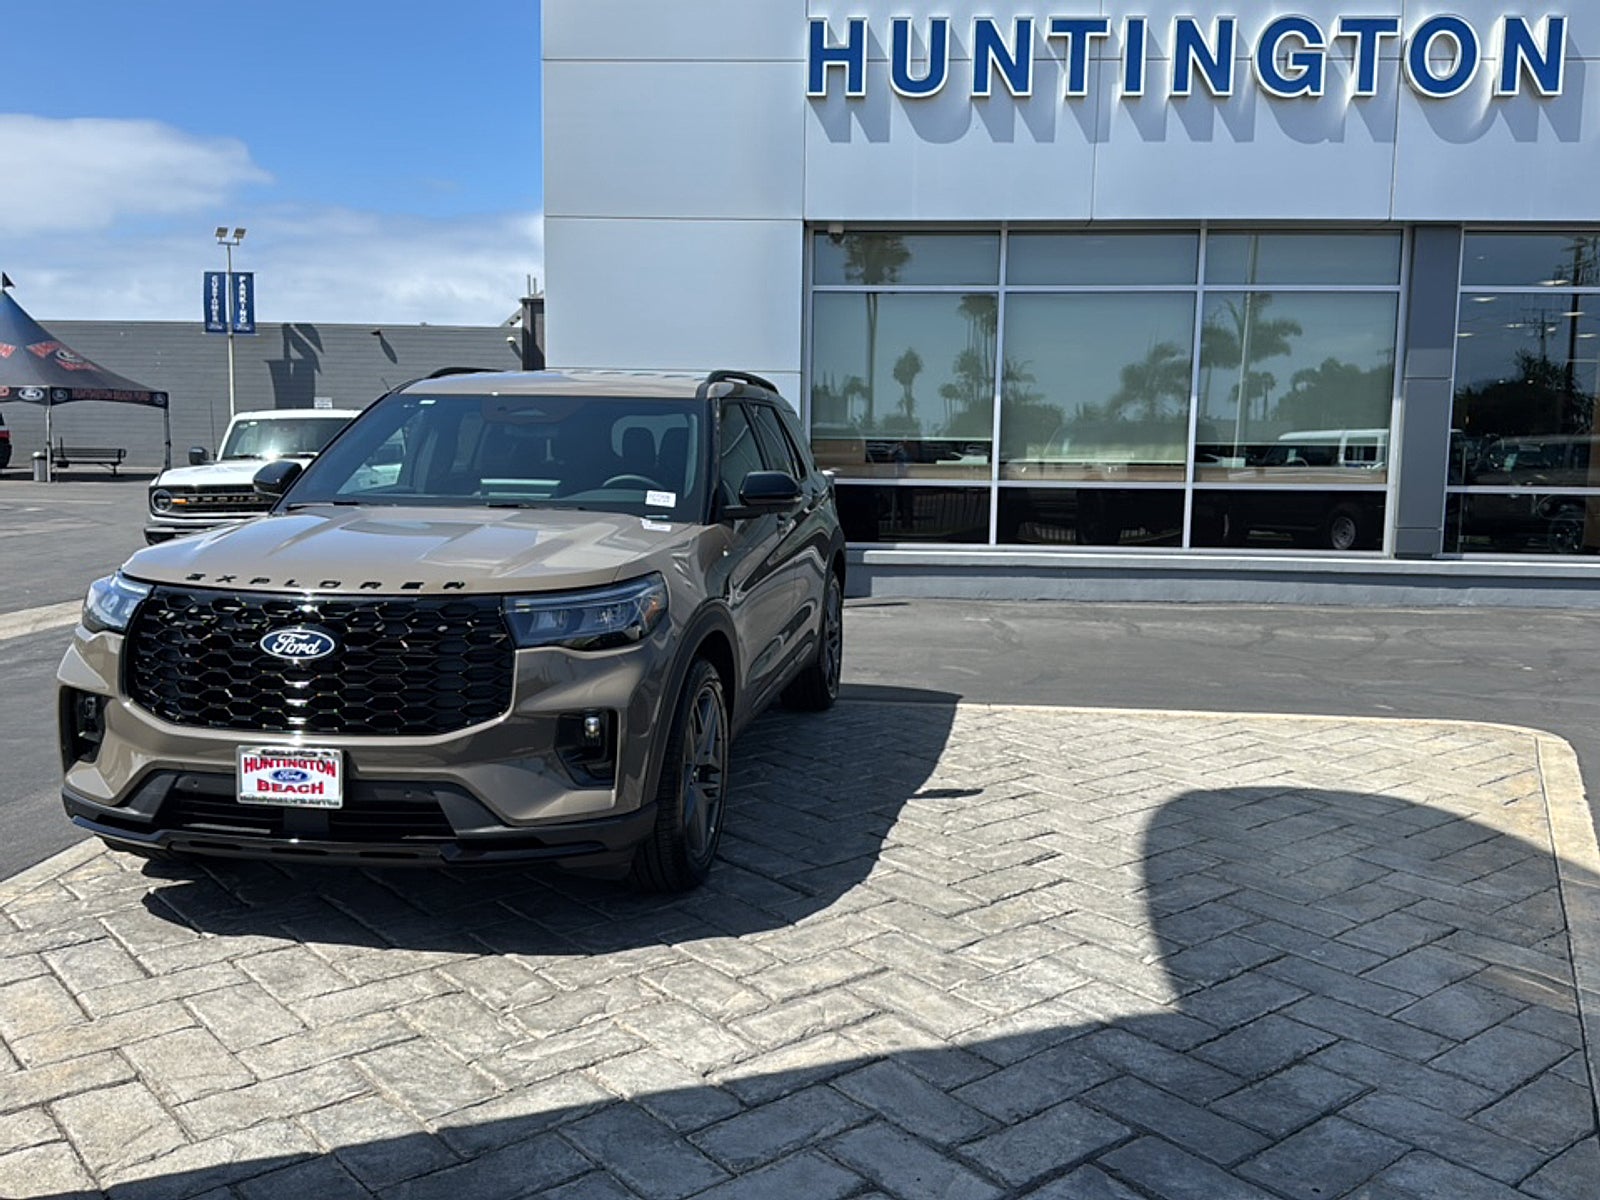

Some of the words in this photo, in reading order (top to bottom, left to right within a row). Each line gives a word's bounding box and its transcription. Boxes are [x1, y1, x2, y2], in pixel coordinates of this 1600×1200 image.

[806, 14, 1568, 99] HUNTINGTON
[239, 275, 247, 323] PARKING
[185, 573, 465, 589] EXPLORER
[271, 633, 320, 655] Ford
[243, 757, 337, 778] HUNTINGTON
[257, 778, 325, 795] BEACH
